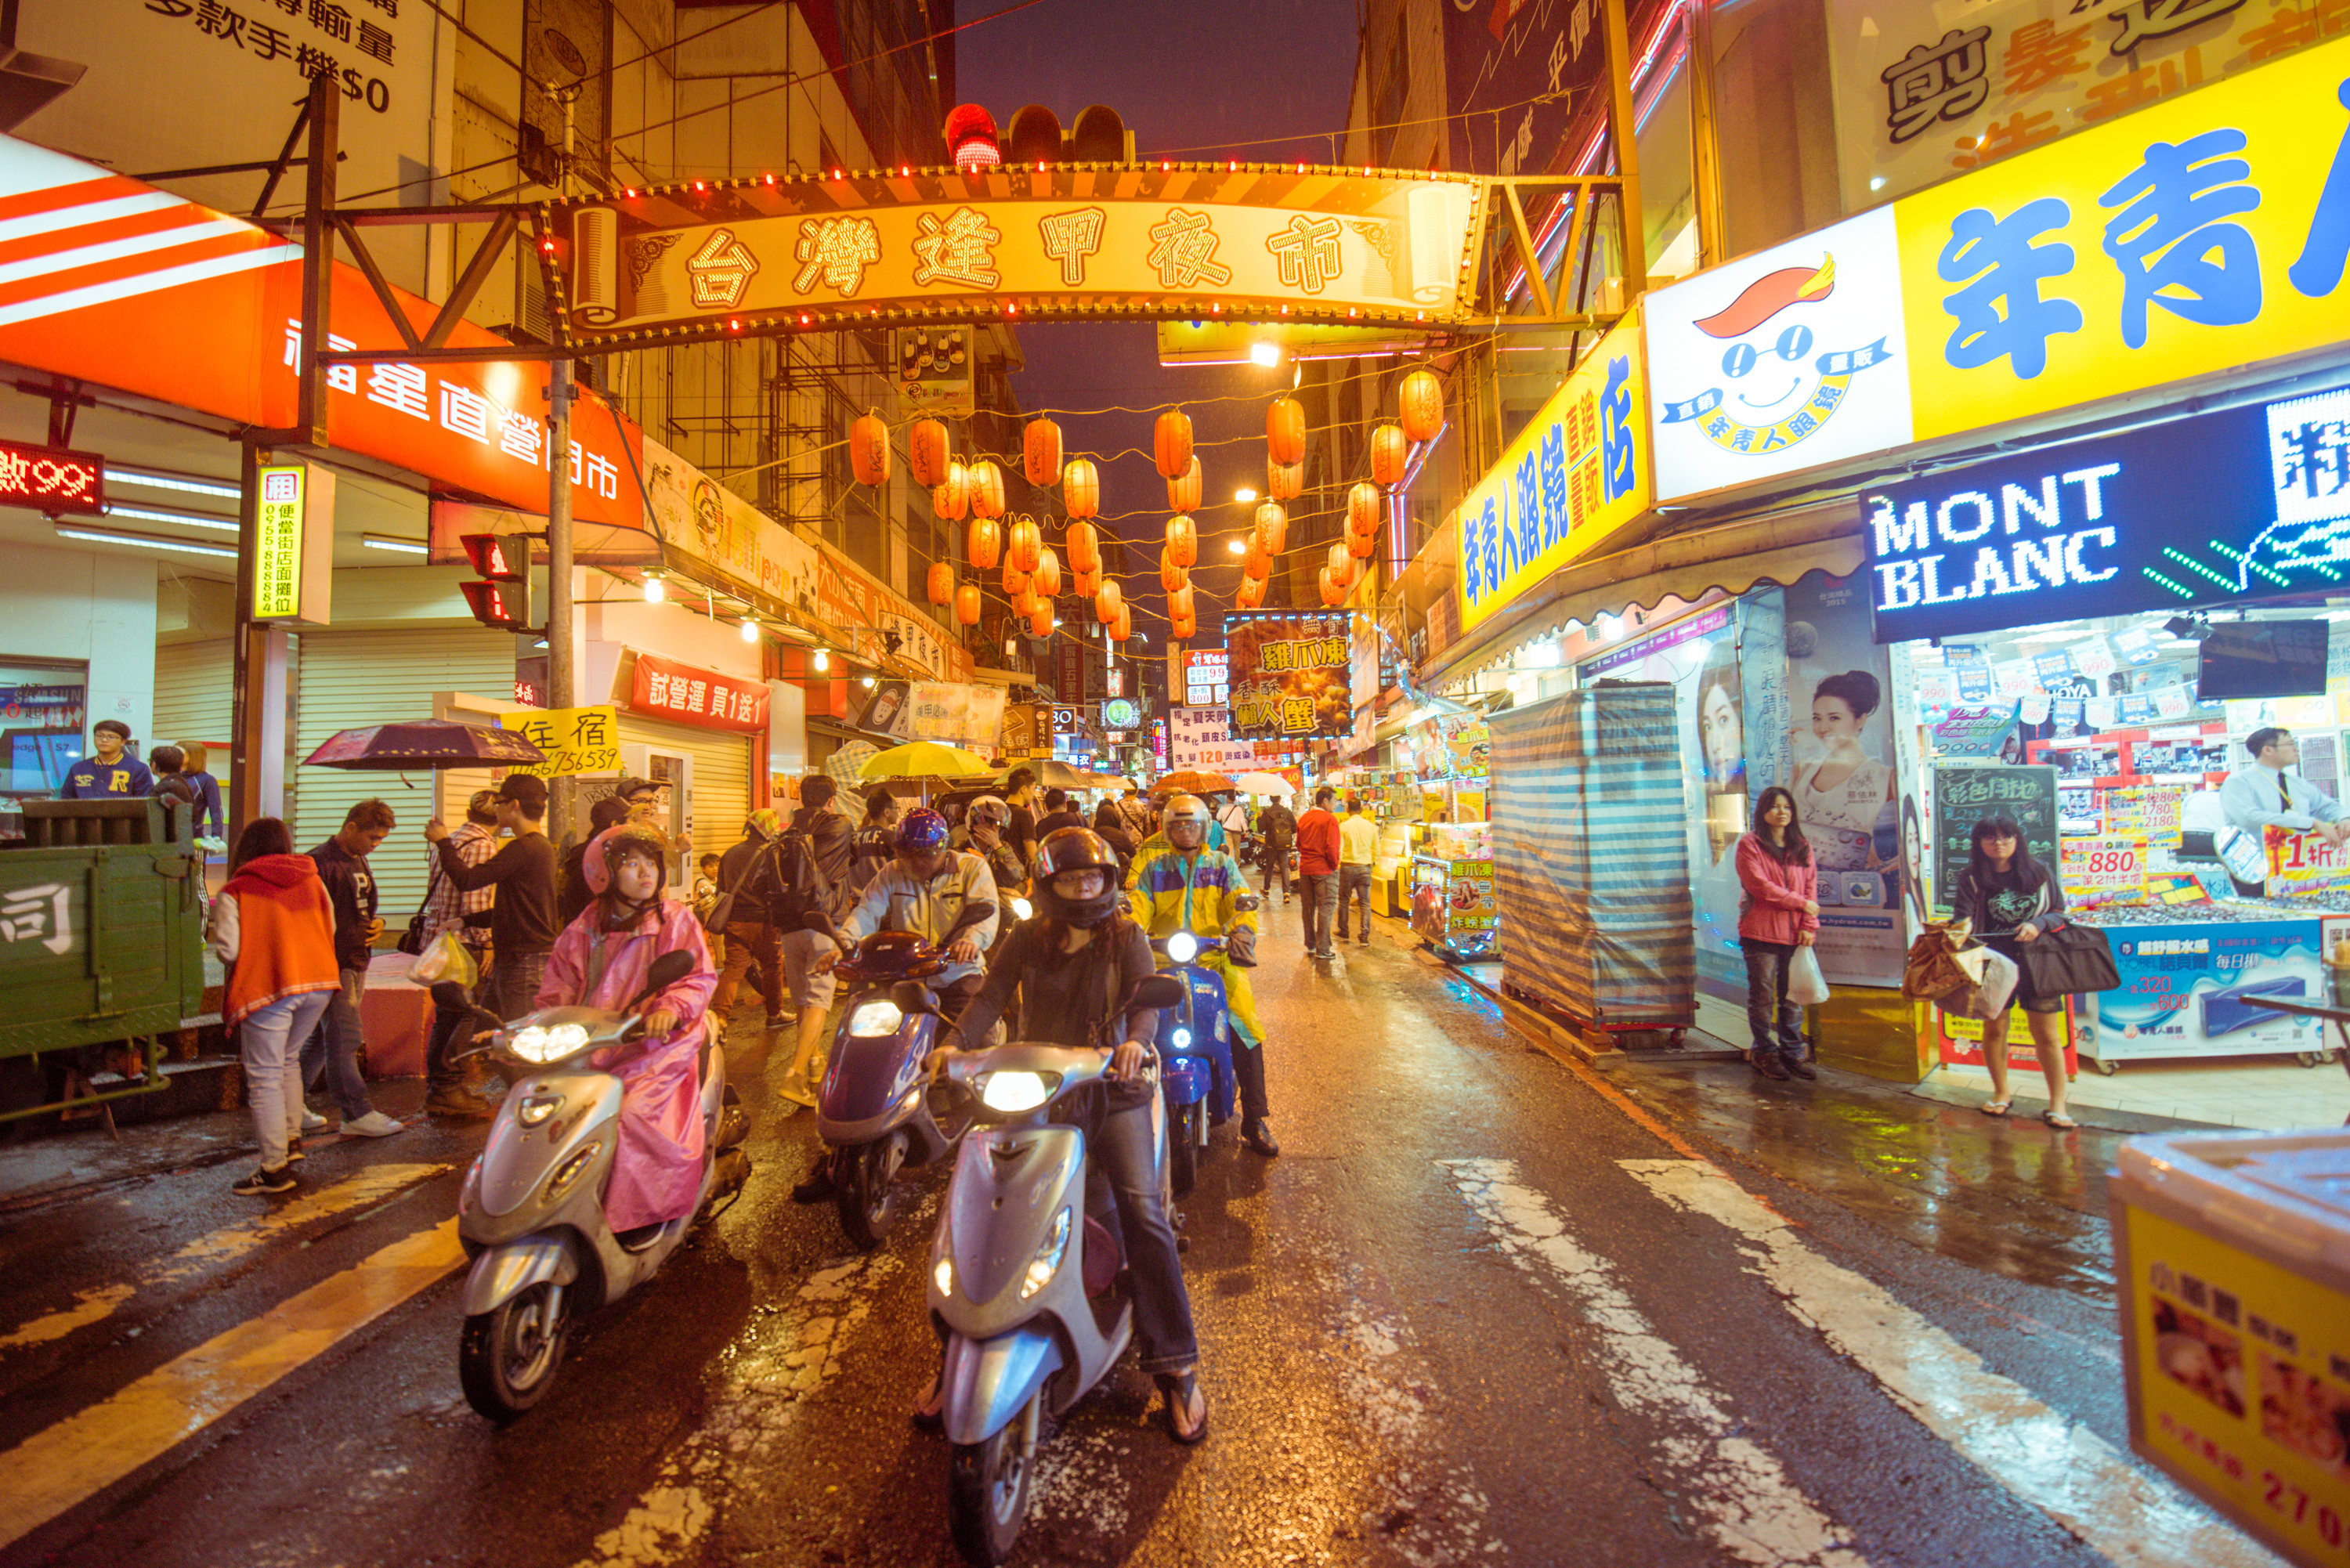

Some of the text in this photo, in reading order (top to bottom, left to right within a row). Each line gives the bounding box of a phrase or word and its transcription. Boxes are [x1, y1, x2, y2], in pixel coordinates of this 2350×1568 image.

[686, 206, 1342, 309] 台灣逢甲夜市
[1829, 346, 1874, 374] 量販
[1678, 392, 1716, 420] 直銷
[1708, 385, 1842, 452] 年青人眼鏡
[1567, 388, 1596, 464] 直銷
[267, 475, 295, 500] 租
[1464, 423, 1569, 606] 年青人眼鏡
[1869, 463, 2120, 556] MONT
[274, 504, 295, 612] 便當街店面攤位
[1875, 526, 2118, 611] BLANC
[1826, 598, 1847, 607] 2015
[1261, 636, 1350, 674] 雞爪凍
[2083, 659, 2109, 674] 990
[649, 671, 761, 724] 試營運 買1送1
[1237, 679, 1282, 700] 香酥
[1922, 688, 1946, 699] 990
[2003, 680, 2027, 692] 990
[519, 713, 607, 749] 住宿
[1236, 697, 1319, 734] 懶人蟹
[1199, 751, 1222, 764] 120
[109, 771, 130, 793] R
[1286, 772, 1299, 782] 40
[2142, 804, 2171, 815] 1780
[2145, 815, 2174, 827] 2180
[2088, 851, 2134, 873] 880
[2285, 834, 2334, 868] 1折
[0, 883, 72, 956] 司
[2261, 1469, 2350, 1551] 270
